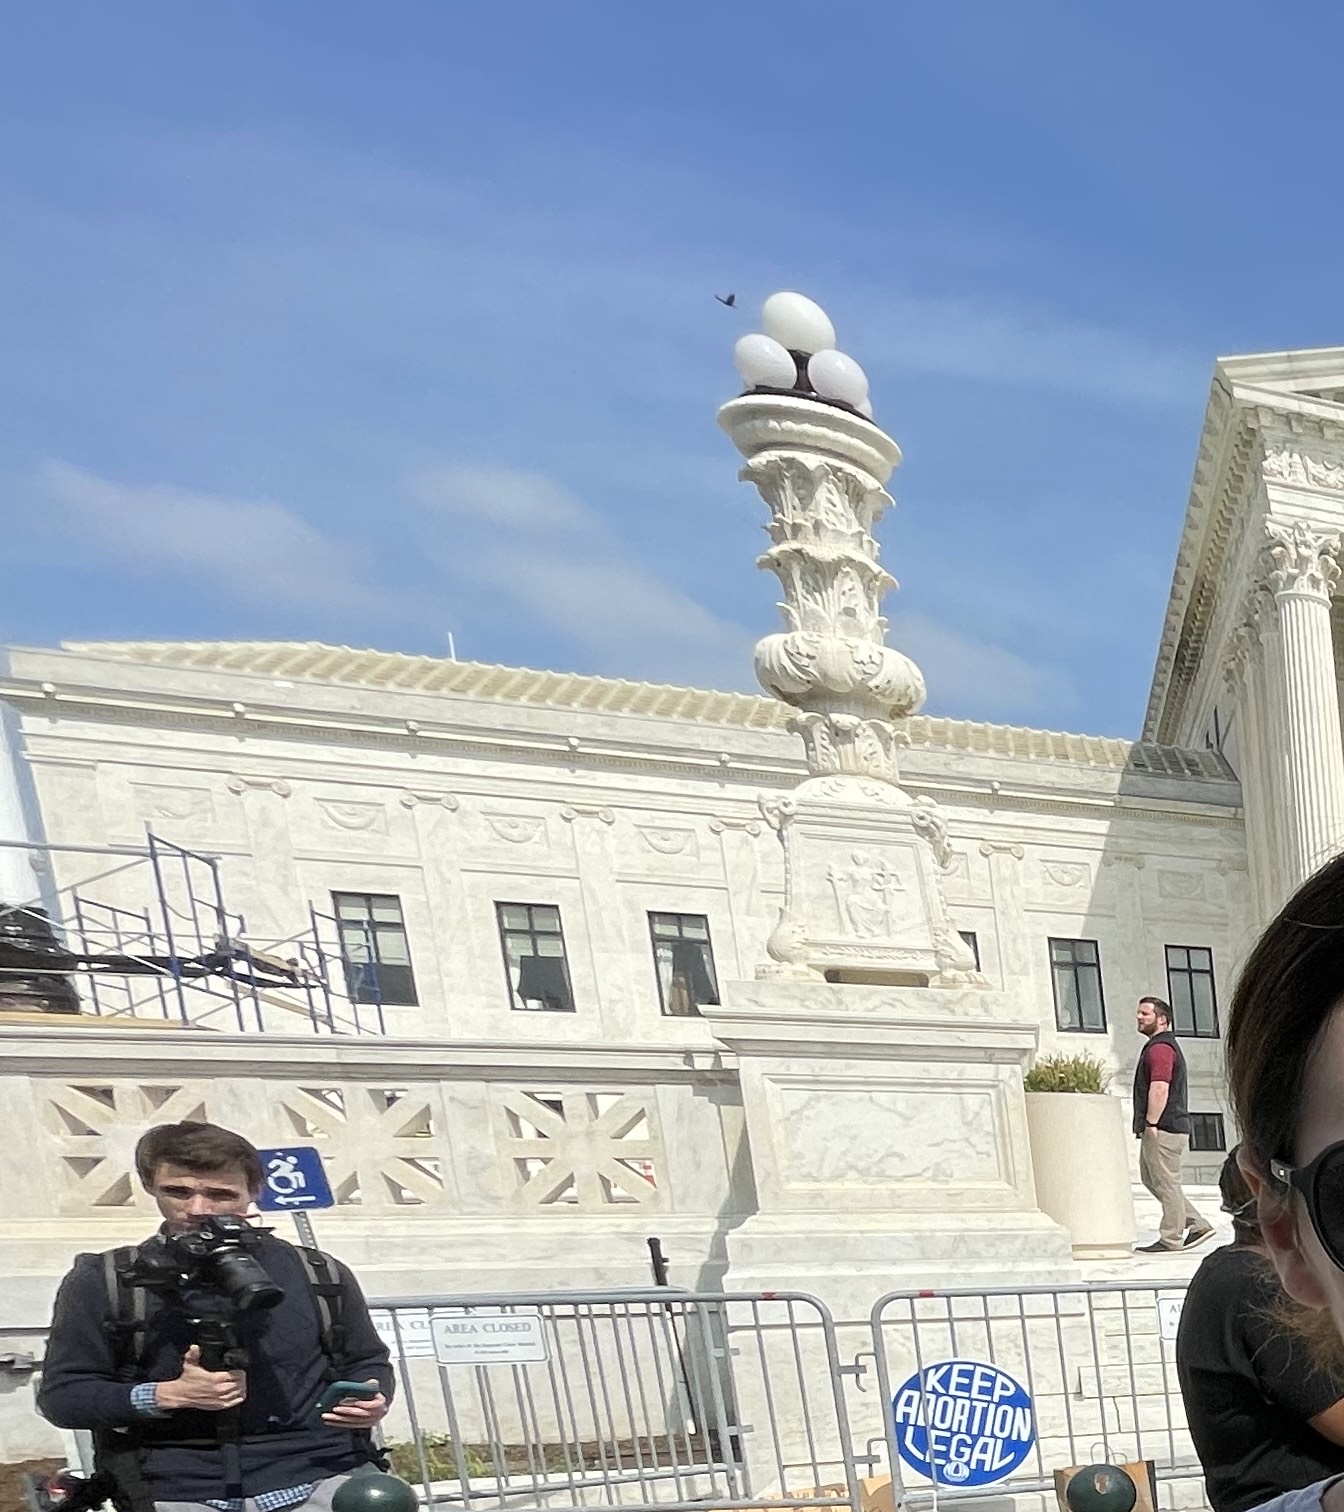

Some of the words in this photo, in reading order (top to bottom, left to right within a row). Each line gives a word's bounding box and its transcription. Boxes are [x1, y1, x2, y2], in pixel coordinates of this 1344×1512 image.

[444, 1324, 478, 1335] AREA
[482, 1322, 531, 1334] CLOSED
[926, 1364, 1016, 1402] KEEP
[896, 1389, 1032, 1442] ABORTION
[904, 1426, 1015, 1472] LEGAL
